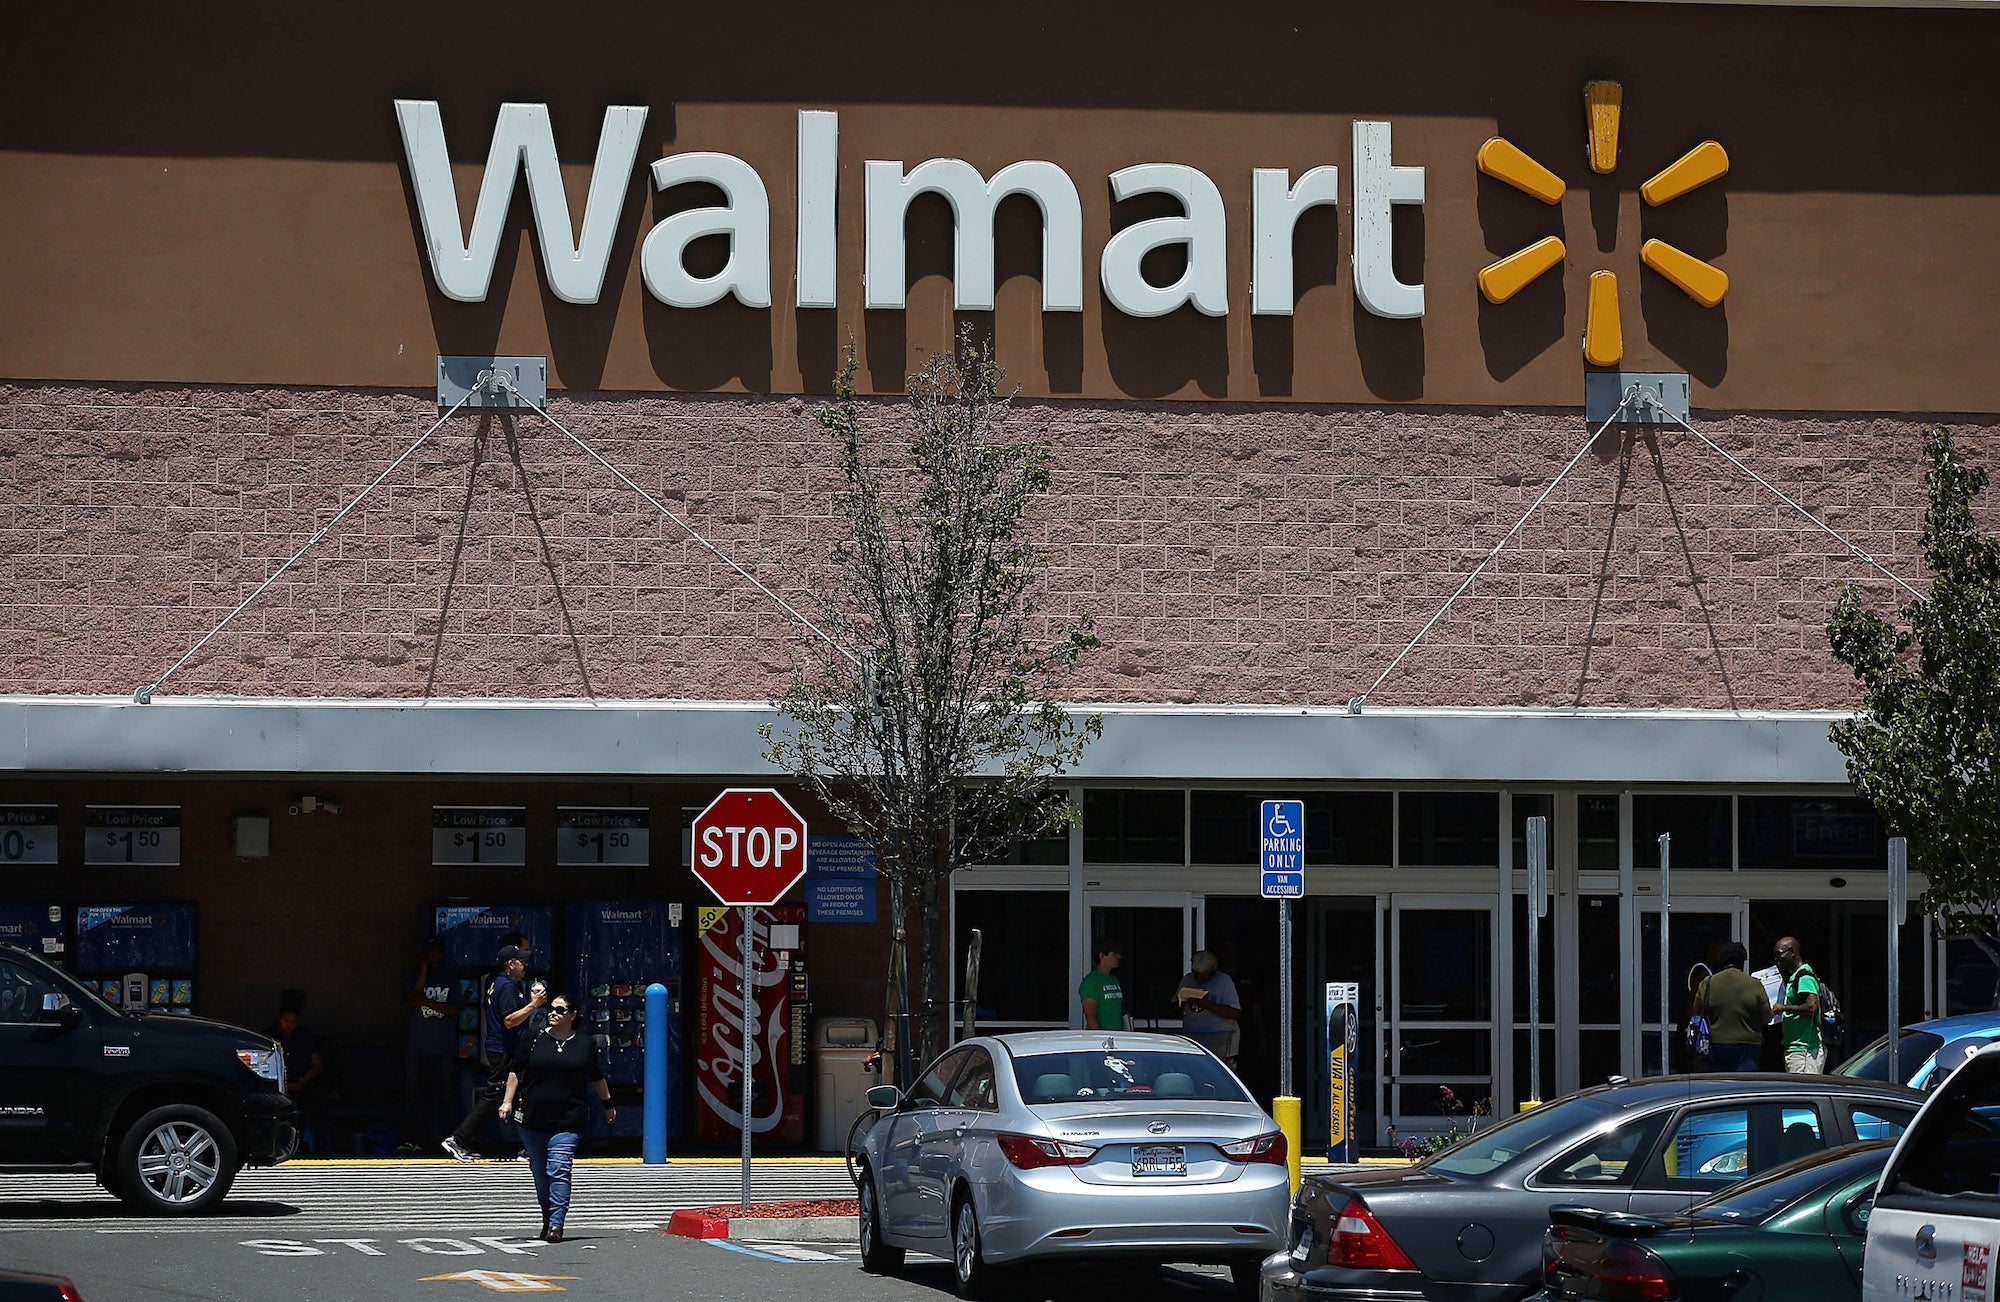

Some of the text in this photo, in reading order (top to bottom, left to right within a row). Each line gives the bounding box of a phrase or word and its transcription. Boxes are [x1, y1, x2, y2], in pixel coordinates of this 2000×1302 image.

[394, 98, 1425, 319] Walmart
[105, 814, 161, 825] Low Price
[452, 815, 507, 826] Low Price
[577, 816, 630, 827] Low Price
[700, 826, 798, 868] STOP
[1263, 837, 1302, 852] PARKING
[1268, 853, 1296, 868] ONLY
[1277, 875, 1289, 884] VAN
[1266, 885, 1299, 894] ACCESSIBLE
[111, 914, 153, 925] Walmart
[468, 914, 510, 925] Walmart
[601, 909, 642, 920] Walmart
[1332, 1056, 1343, 1136] VIVA 3 ALL-SEASON
[1348, 1066, 1357, 1141] GOODYEAR
[238, 1236, 553, 1257] STOP
